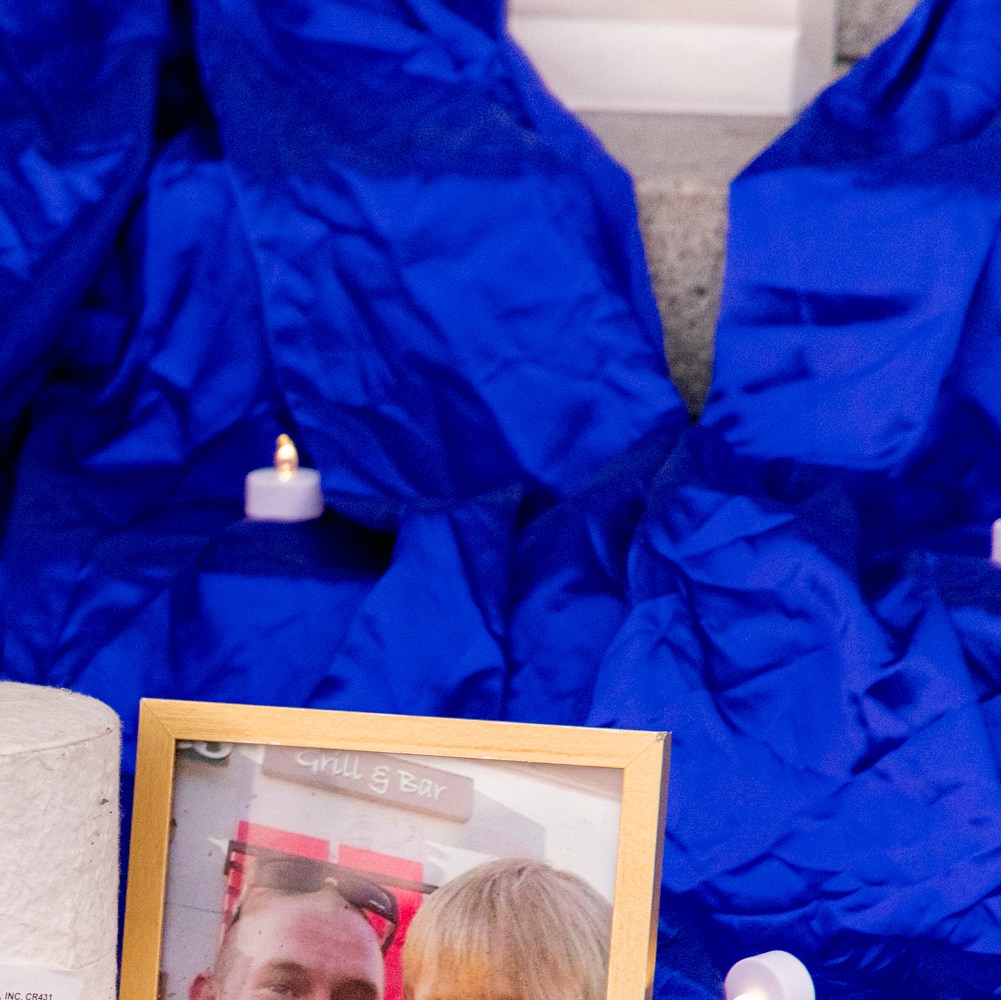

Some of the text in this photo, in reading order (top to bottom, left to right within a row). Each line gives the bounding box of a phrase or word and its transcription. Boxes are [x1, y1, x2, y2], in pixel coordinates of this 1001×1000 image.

[296, 749, 448, 800] Grill & Bar
[26, 993, 52, 1000] CR431
